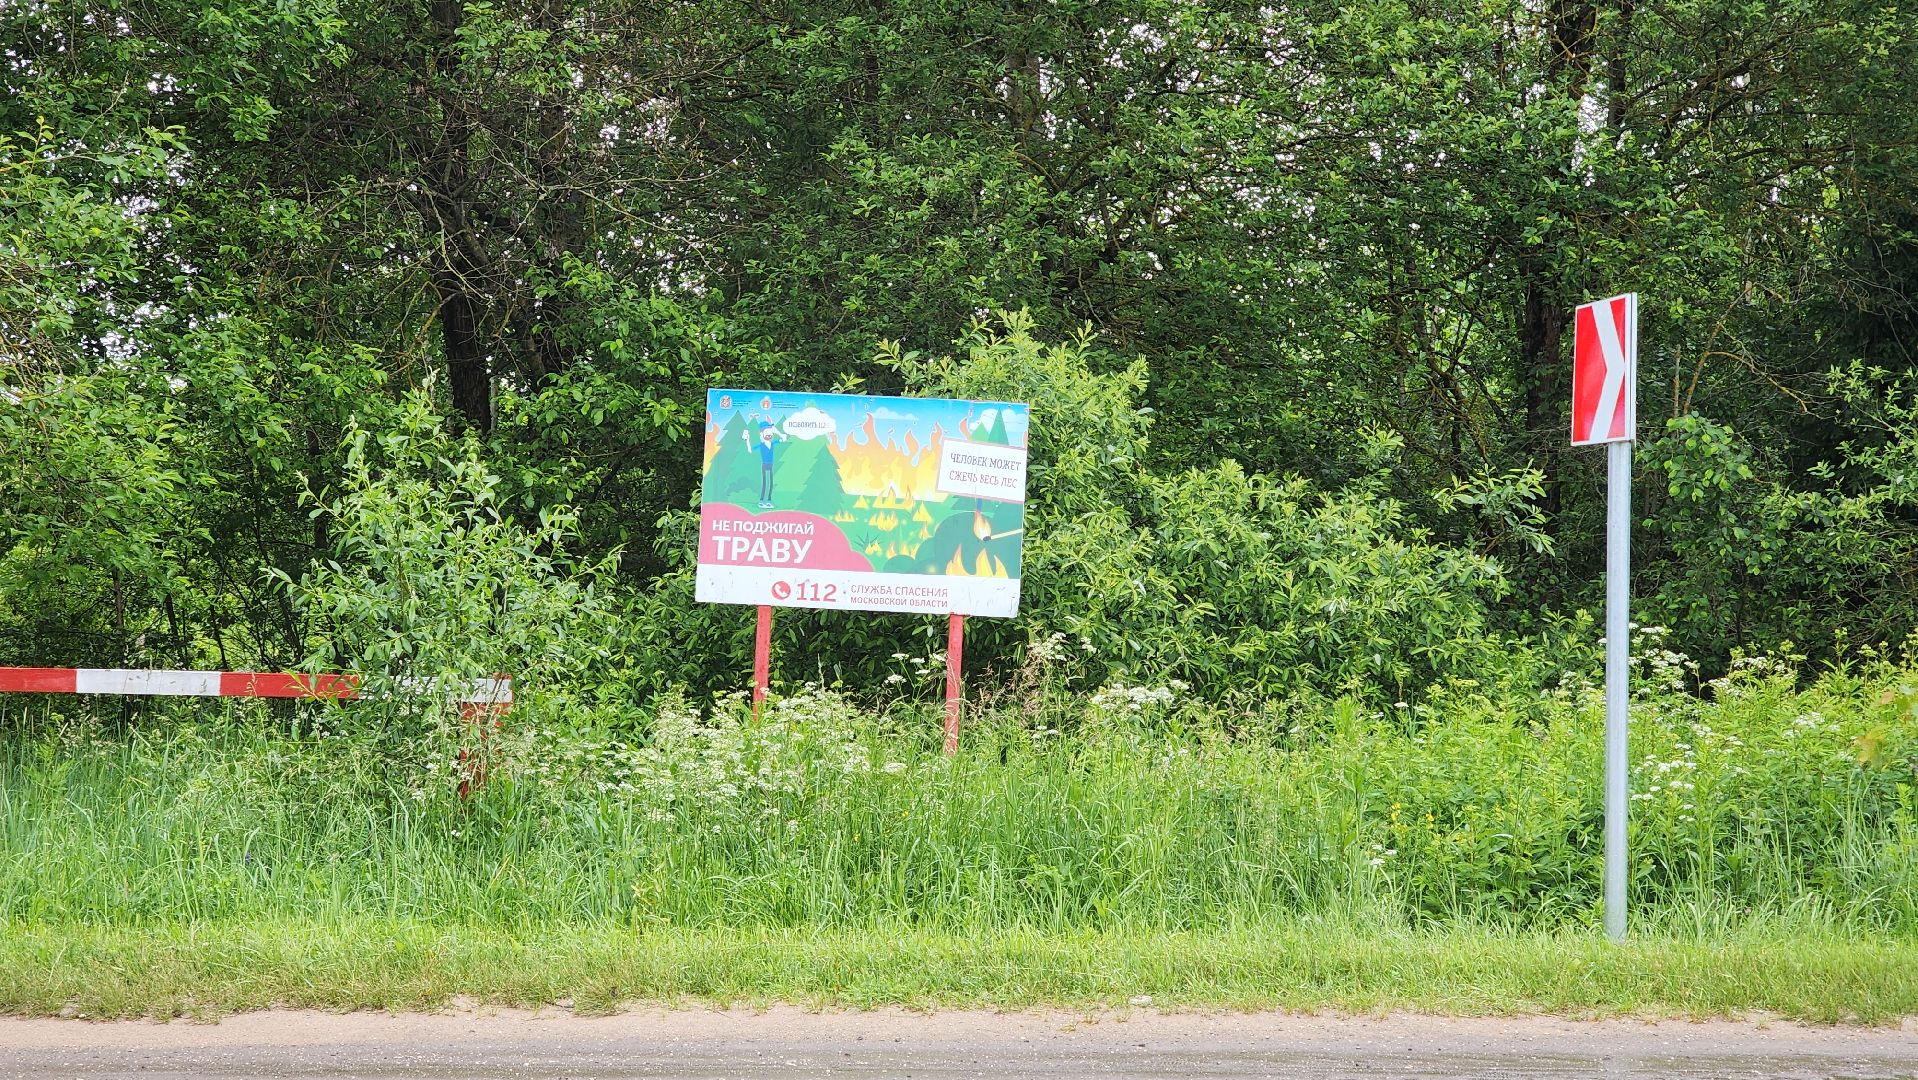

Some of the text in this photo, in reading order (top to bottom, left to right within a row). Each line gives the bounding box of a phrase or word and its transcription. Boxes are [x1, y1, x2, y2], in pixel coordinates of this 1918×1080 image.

[950, 453, 1022, 471] ЧЕЛОВЕК МОЖЕТ
[949, 470, 1018, 488] СЖЕЧЬ ВЕСЬ ЛЕС
[712, 519, 814, 535] НЕ ПОДЖИГАЙ
[712, 535, 813, 564] ТРАВУ
[796, 582, 837, 602] 112
[850, 584, 948, 598] СЛУЖБА СПАСЕНИЯ
[909, 599, 948, 608] ОБЛАСТИ
